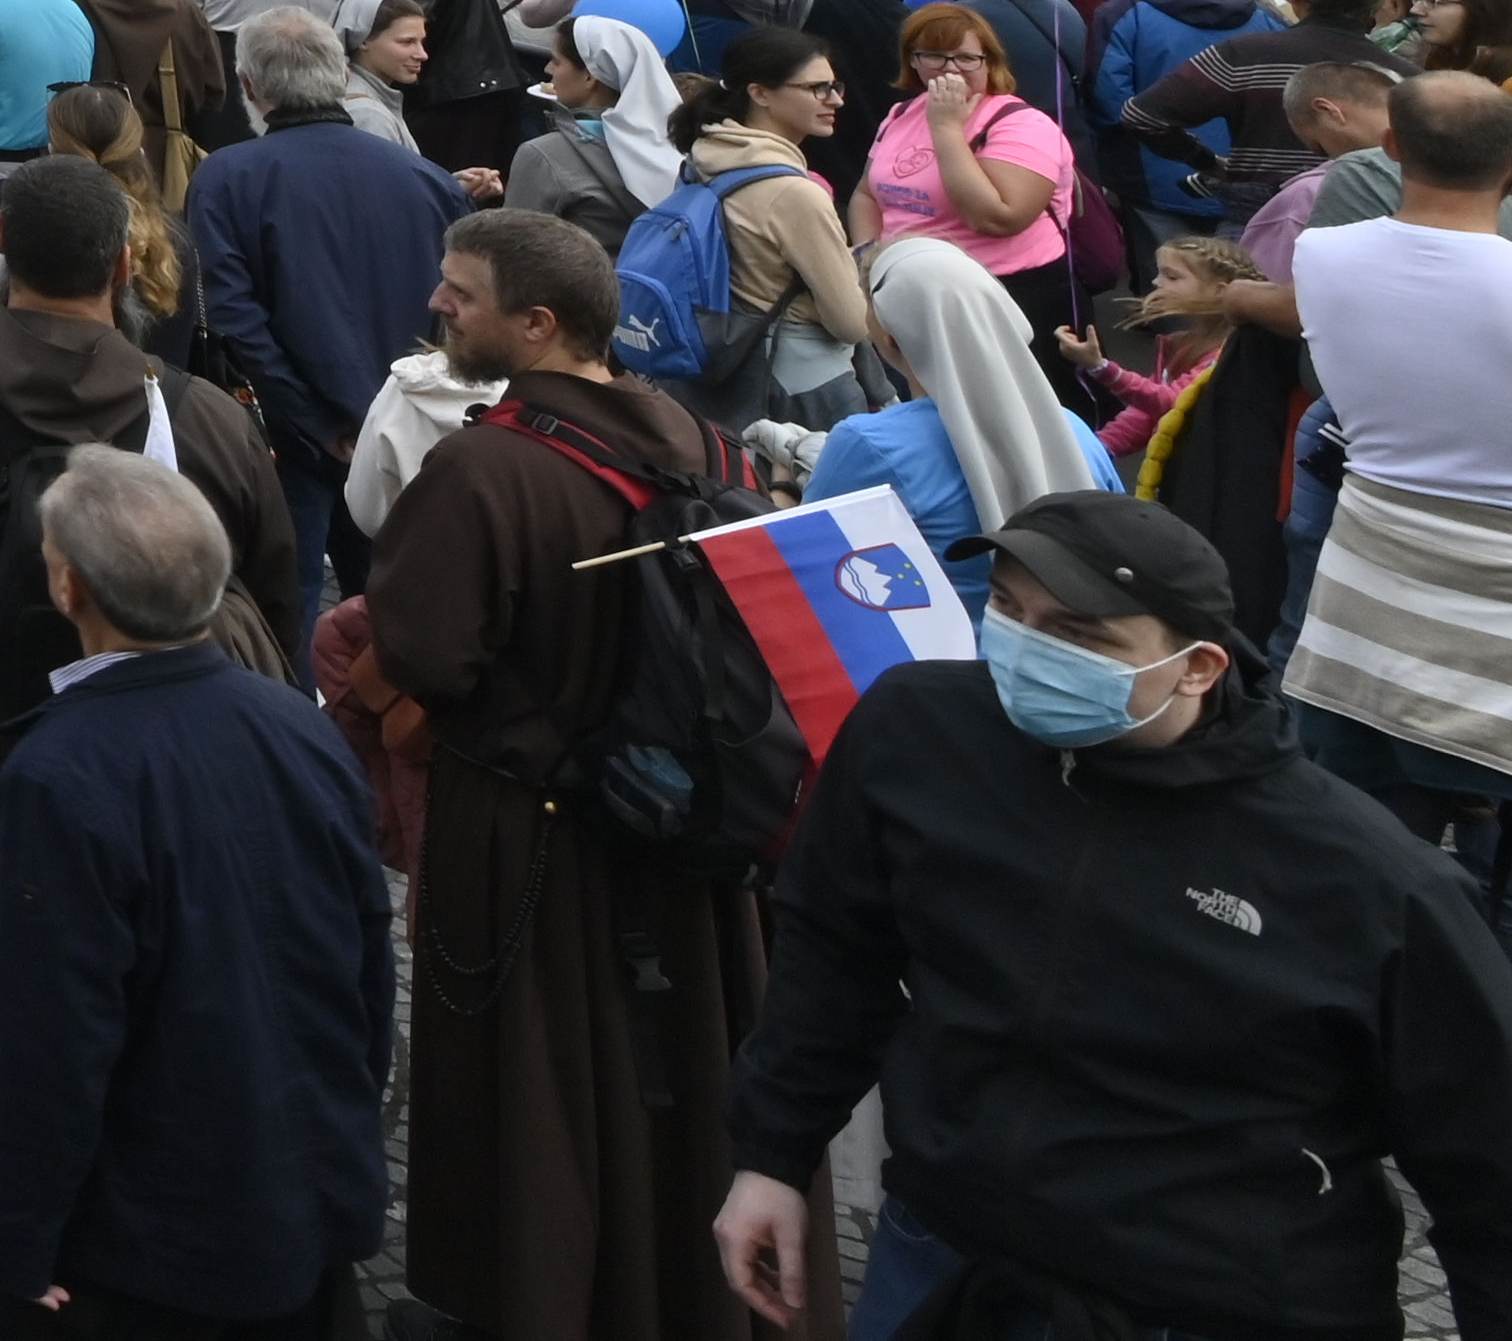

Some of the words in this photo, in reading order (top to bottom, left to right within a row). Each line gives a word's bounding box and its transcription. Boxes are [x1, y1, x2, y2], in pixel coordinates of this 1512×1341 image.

[1185, 887, 1237, 915] NORTH
[1212, 888, 1239, 904] THE
[1197, 901, 1233, 925] FACE
